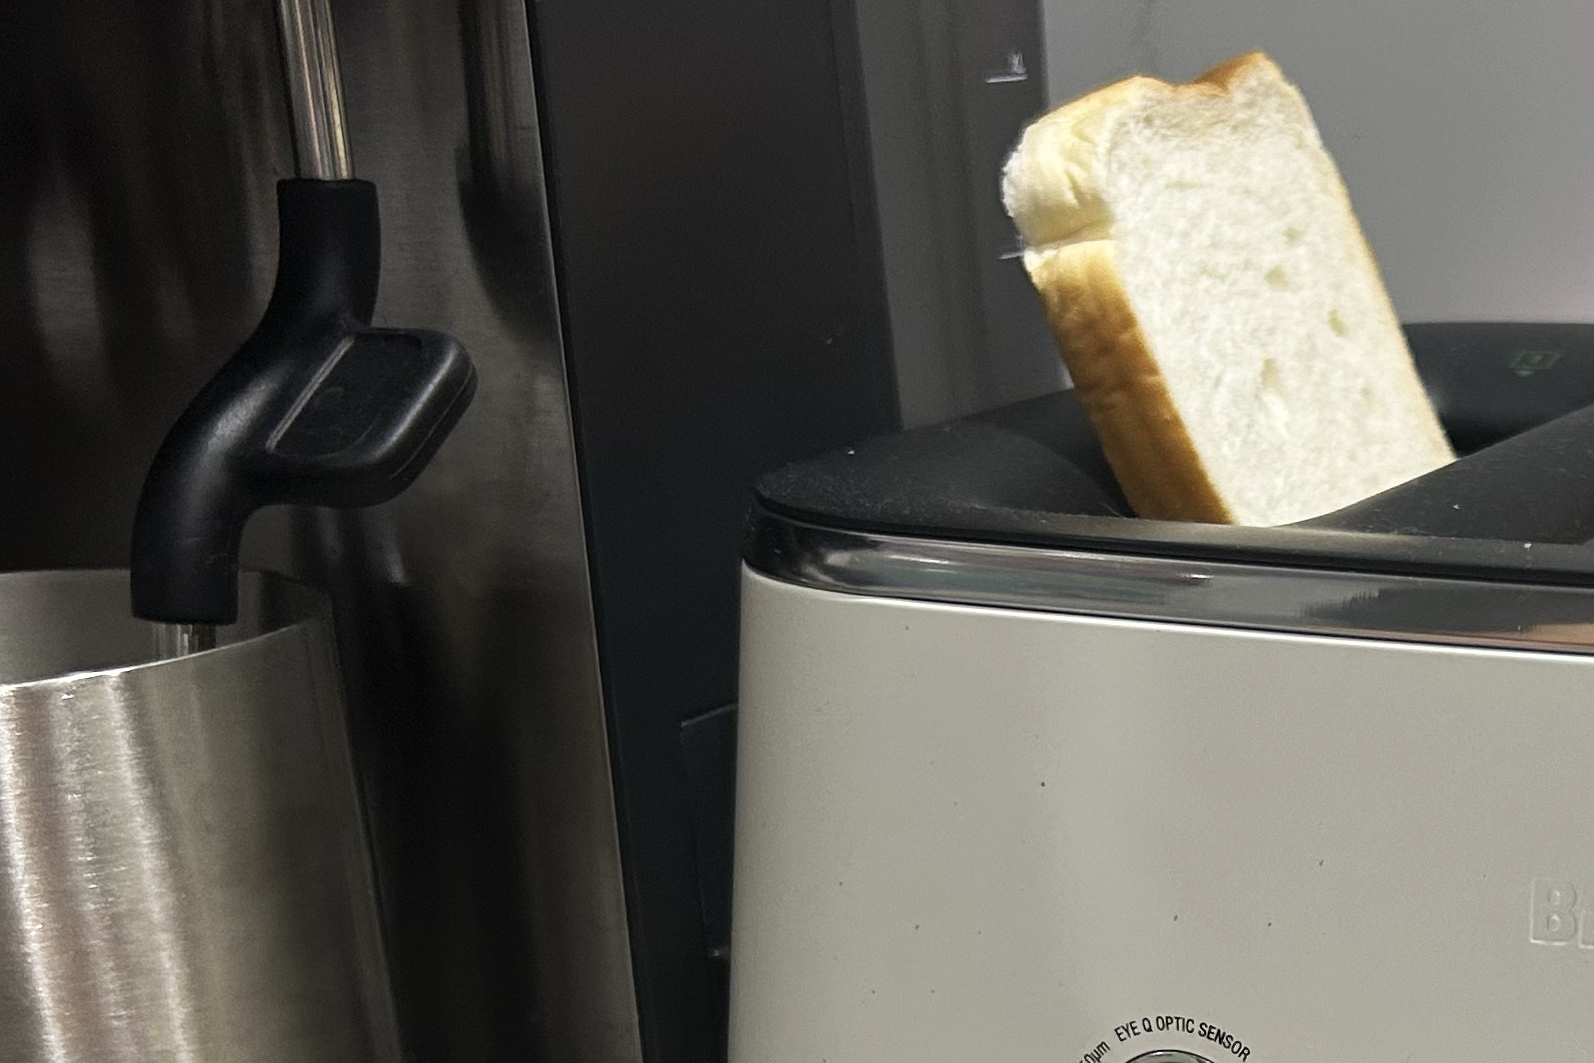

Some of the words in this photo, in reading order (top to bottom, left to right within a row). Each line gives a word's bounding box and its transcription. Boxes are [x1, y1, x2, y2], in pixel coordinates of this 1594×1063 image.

[1114, 1019, 1141, 1042] EYE
[1142, 1018, 1153, 1032] Q
[1156, 1016, 1195, 1034] OPTIC
[1198, 1022, 1251, 1062] SENSOR
